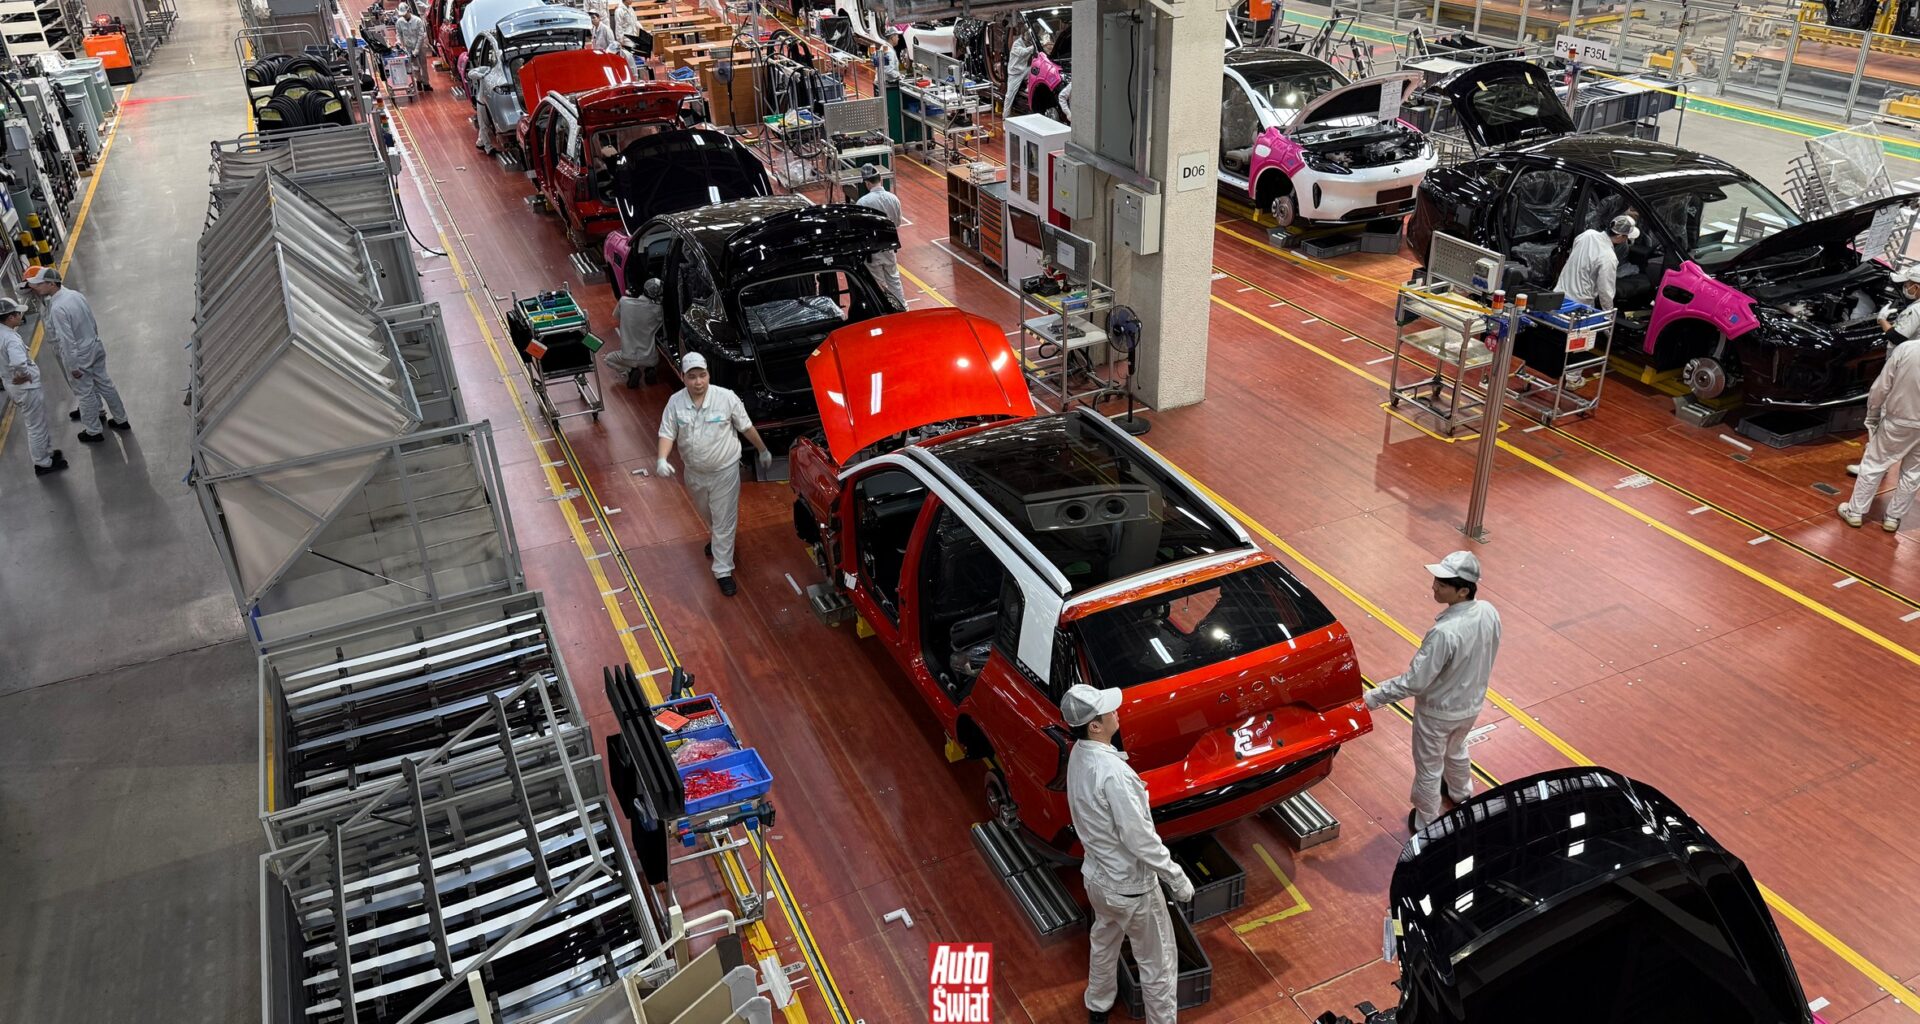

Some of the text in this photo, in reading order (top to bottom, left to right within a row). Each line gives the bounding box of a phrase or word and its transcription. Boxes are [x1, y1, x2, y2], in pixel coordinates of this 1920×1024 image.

[1583, 46, 1608, 61] F35L
[1183, 164, 1205, 178] D06
[1217, 675, 1286, 704] AION
